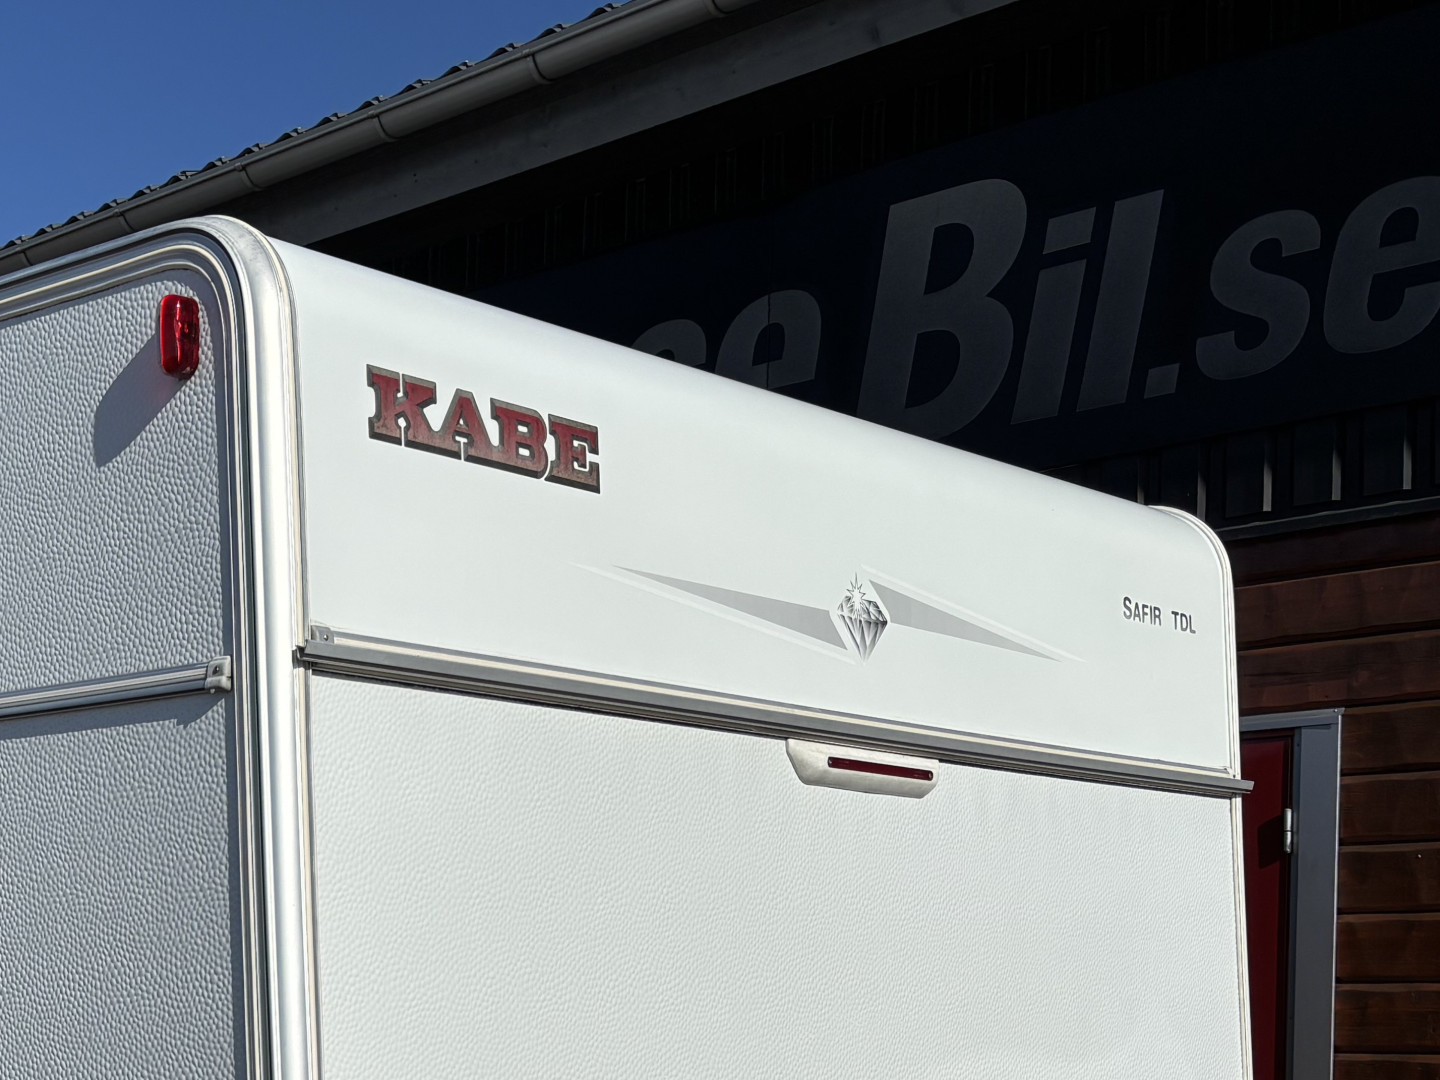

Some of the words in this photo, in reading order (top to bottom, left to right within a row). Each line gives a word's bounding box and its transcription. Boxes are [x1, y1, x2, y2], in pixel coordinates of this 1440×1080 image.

[366, 364, 601, 494] KABE
[1122, 596, 1162, 626] SAFIR
[1171, 610, 1196, 634] TDL
